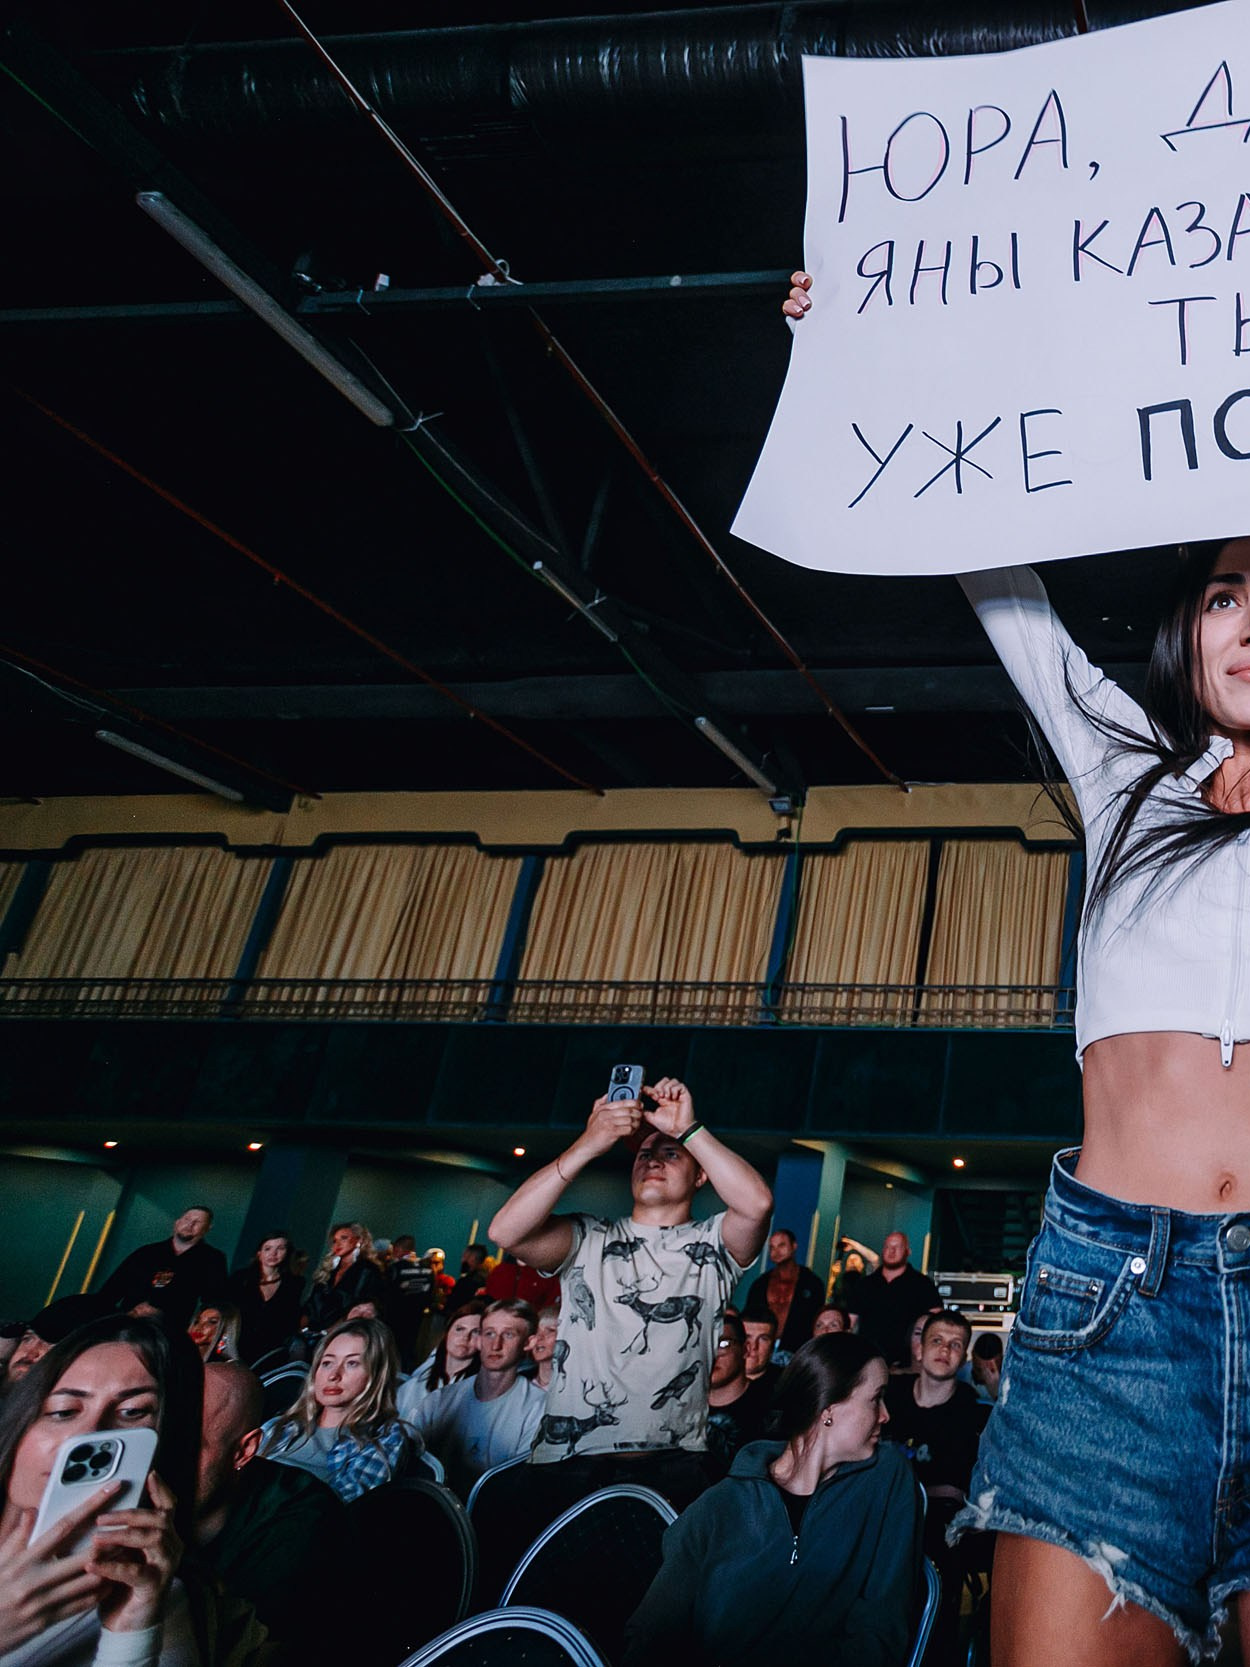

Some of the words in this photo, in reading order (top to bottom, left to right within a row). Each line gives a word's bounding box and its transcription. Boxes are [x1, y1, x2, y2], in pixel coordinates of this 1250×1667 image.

[837, 88, 1101, 224] ЮРА,
[856, 232, 1021, 315] ЯНЫ
[847, 409, 1074, 509] УЖЕ
